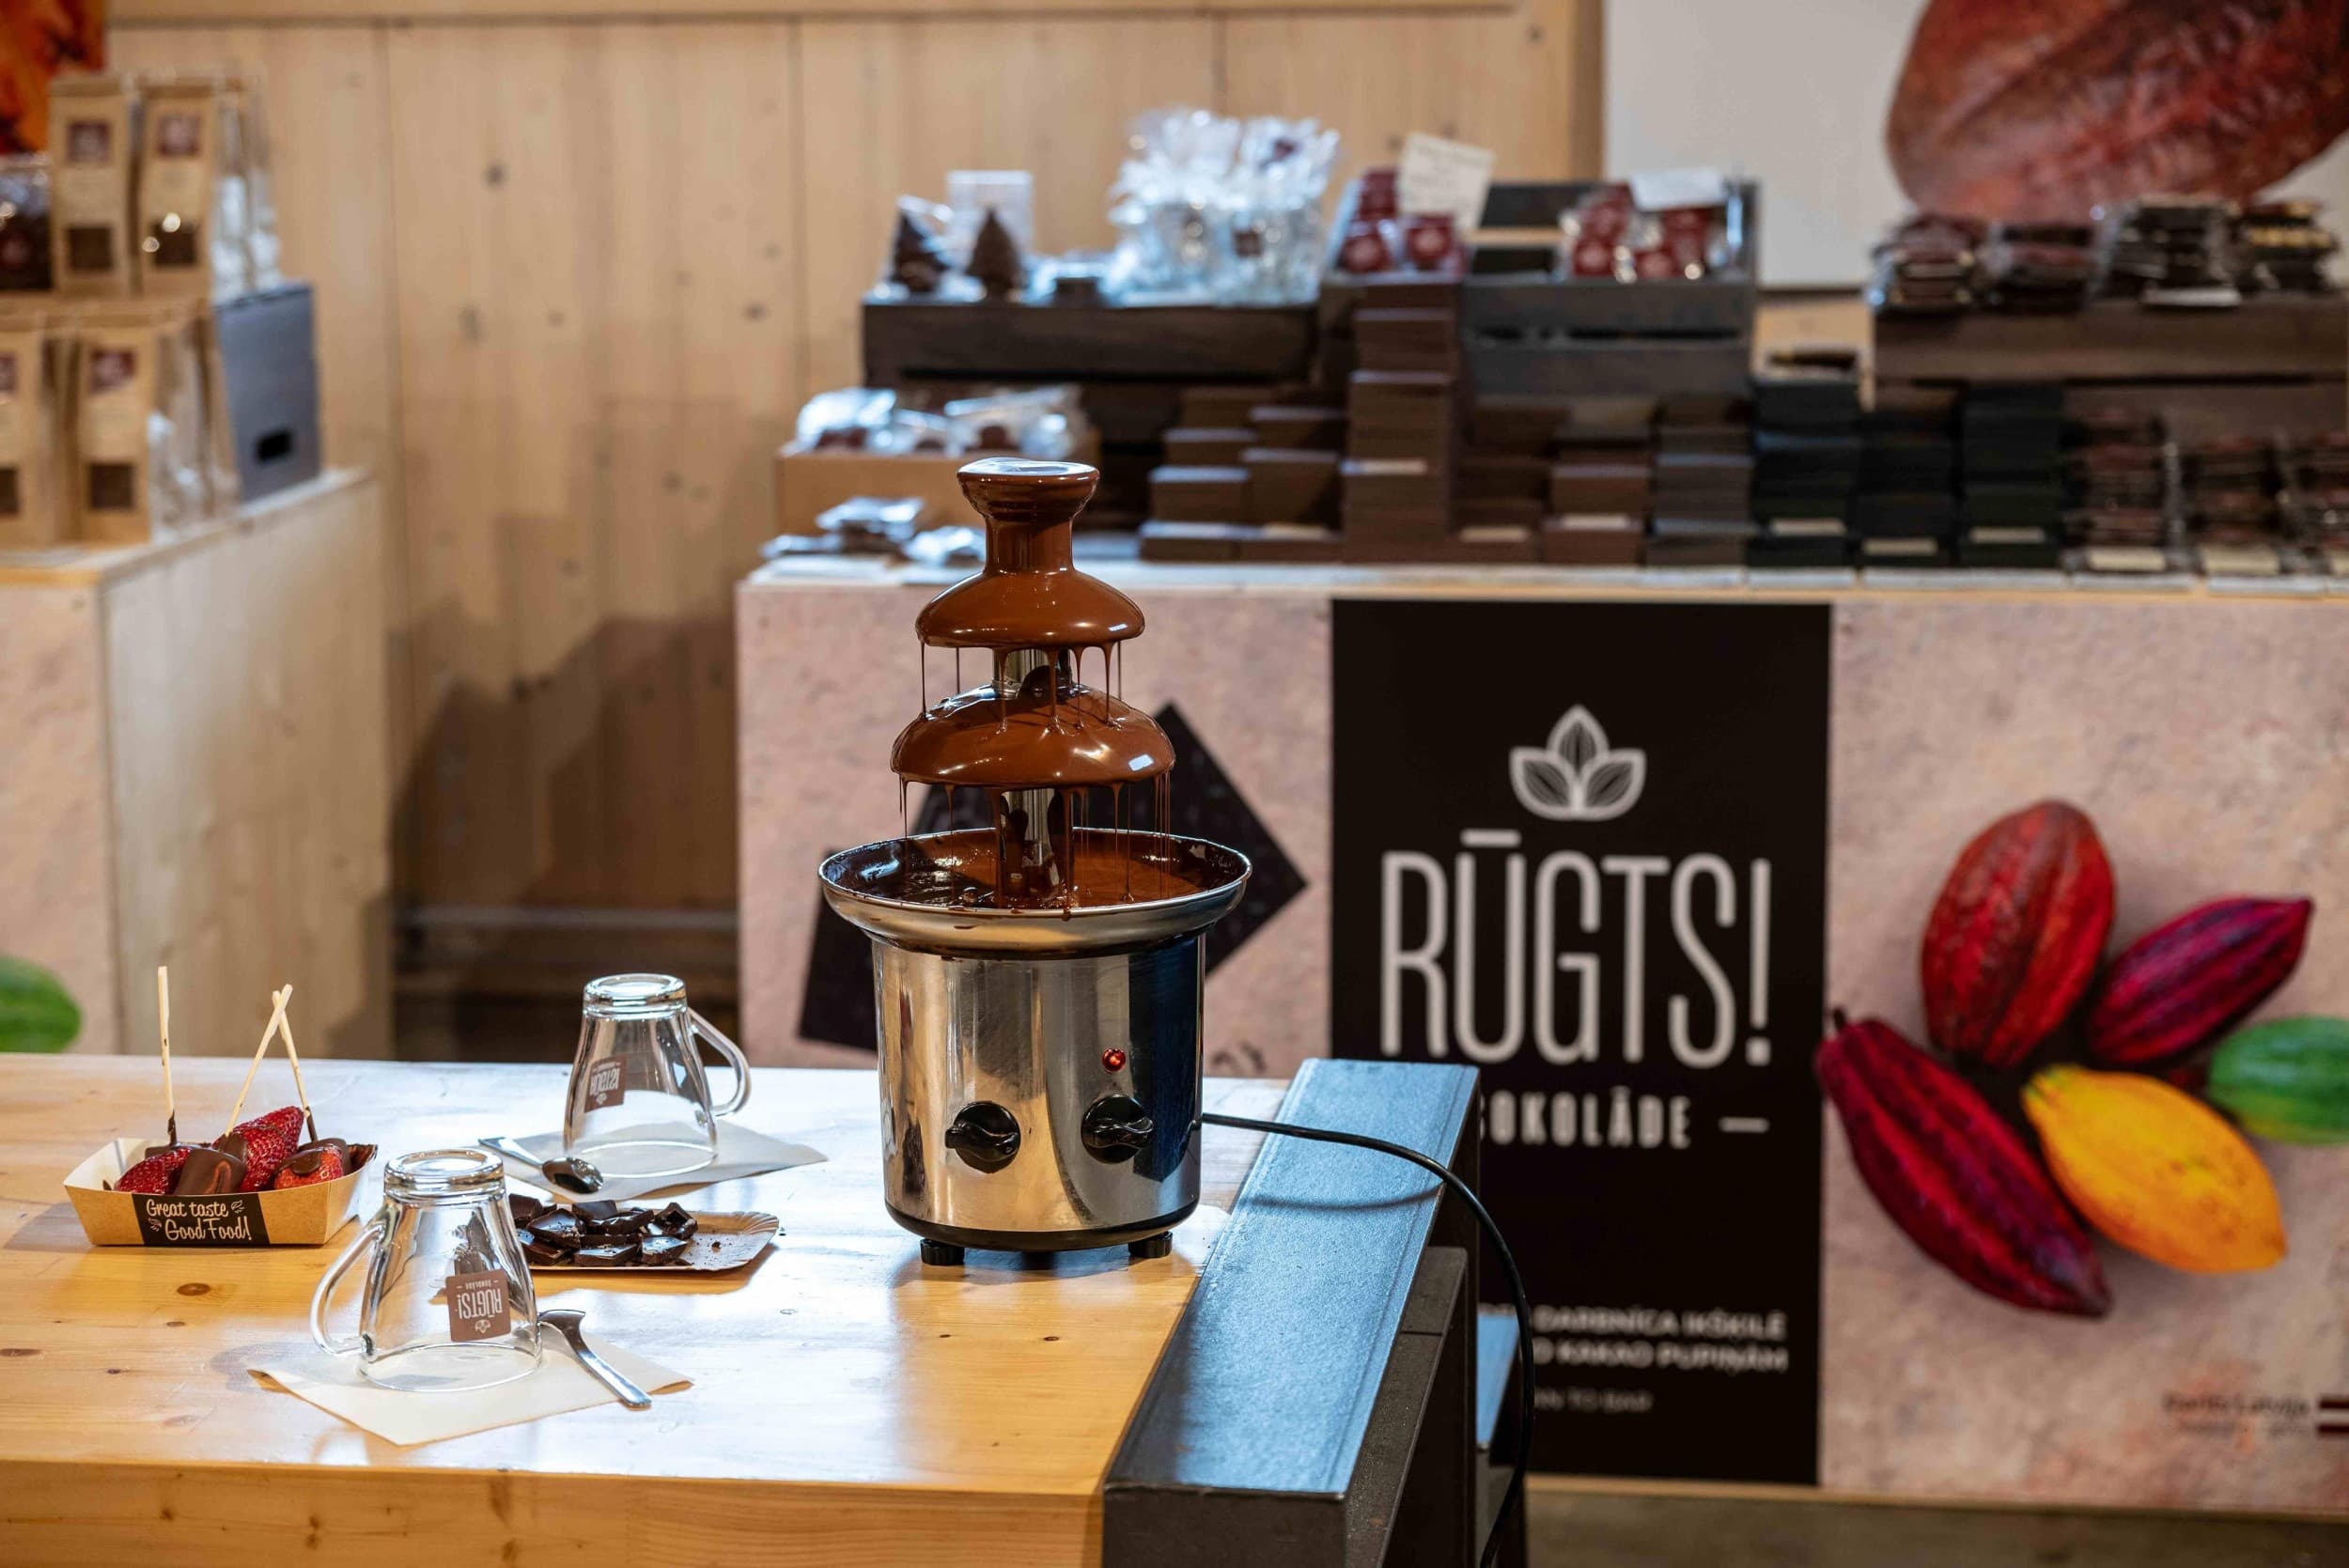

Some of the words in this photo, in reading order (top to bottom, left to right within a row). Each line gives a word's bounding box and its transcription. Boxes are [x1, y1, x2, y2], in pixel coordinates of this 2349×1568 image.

[1380, 829, 1772, 1069] RŪGTS!
[1481, 1085, 1691, 1150] OKOLĀDE
[146, 1198, 187, 1218] Great
[189, 1202, 229, 1218] taste
[164, 1217, 206, 1241] Good
[203, 1216, 252, 1241] Food!
[457, 1288, 503, 1320] RŪGTS!
[1555, 1339, 1654, 1368] KAKAO
